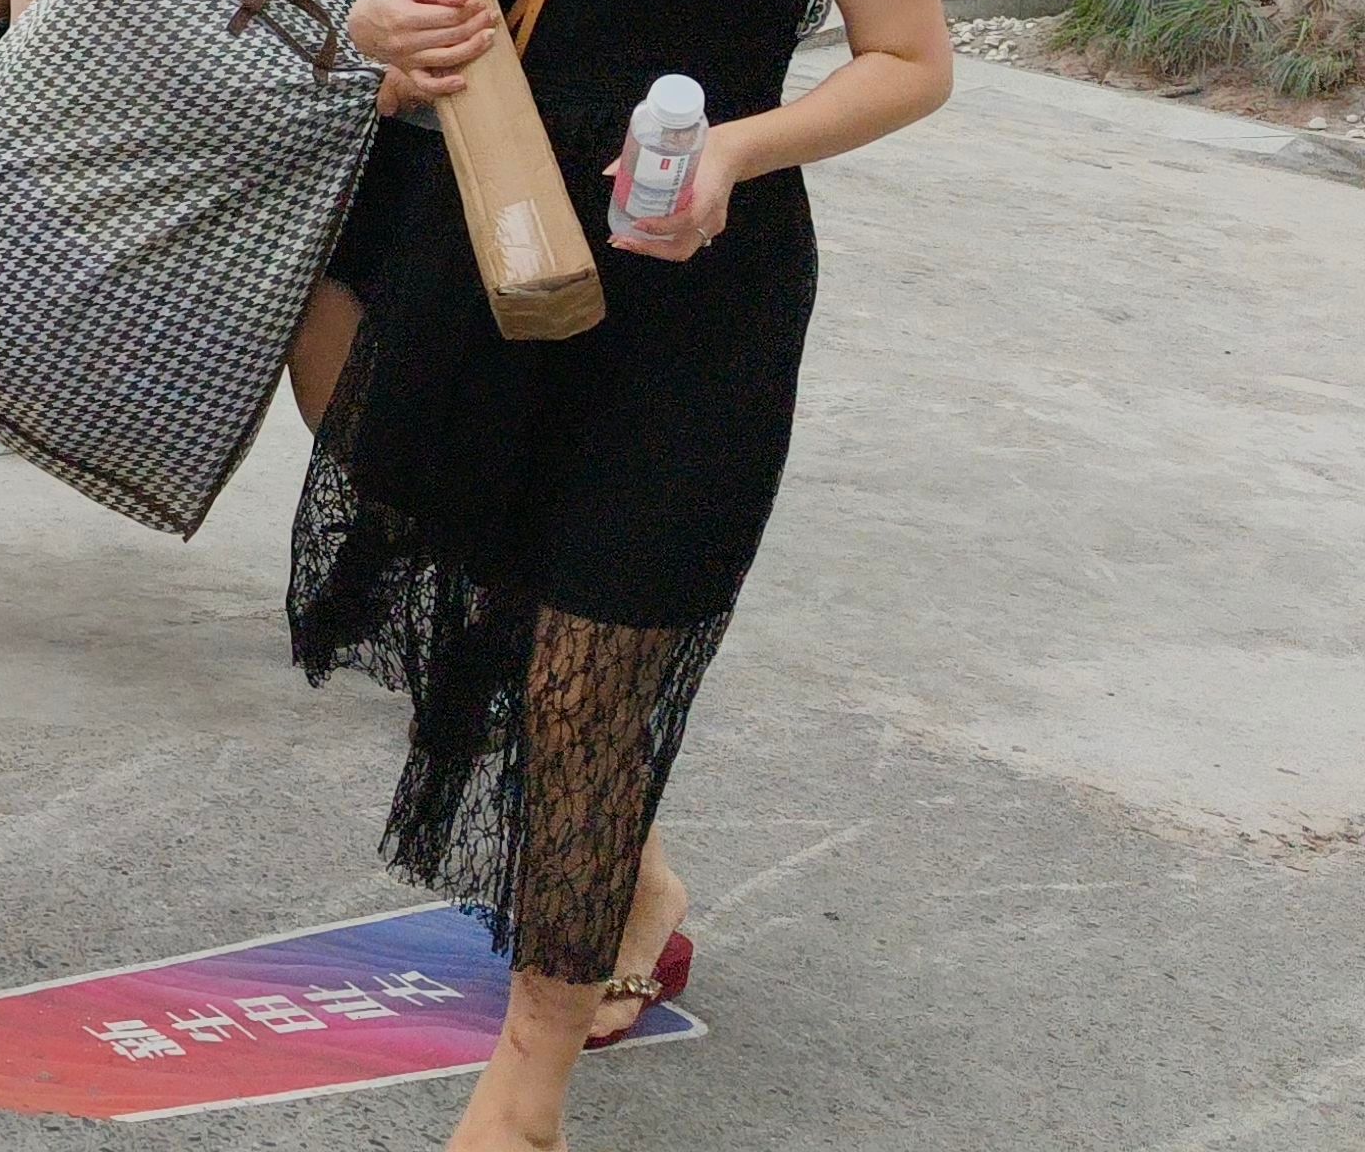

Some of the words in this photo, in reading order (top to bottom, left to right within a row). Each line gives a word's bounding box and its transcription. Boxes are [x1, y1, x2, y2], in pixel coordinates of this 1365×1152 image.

[82, 969, 465, 1062] 新生由此去
